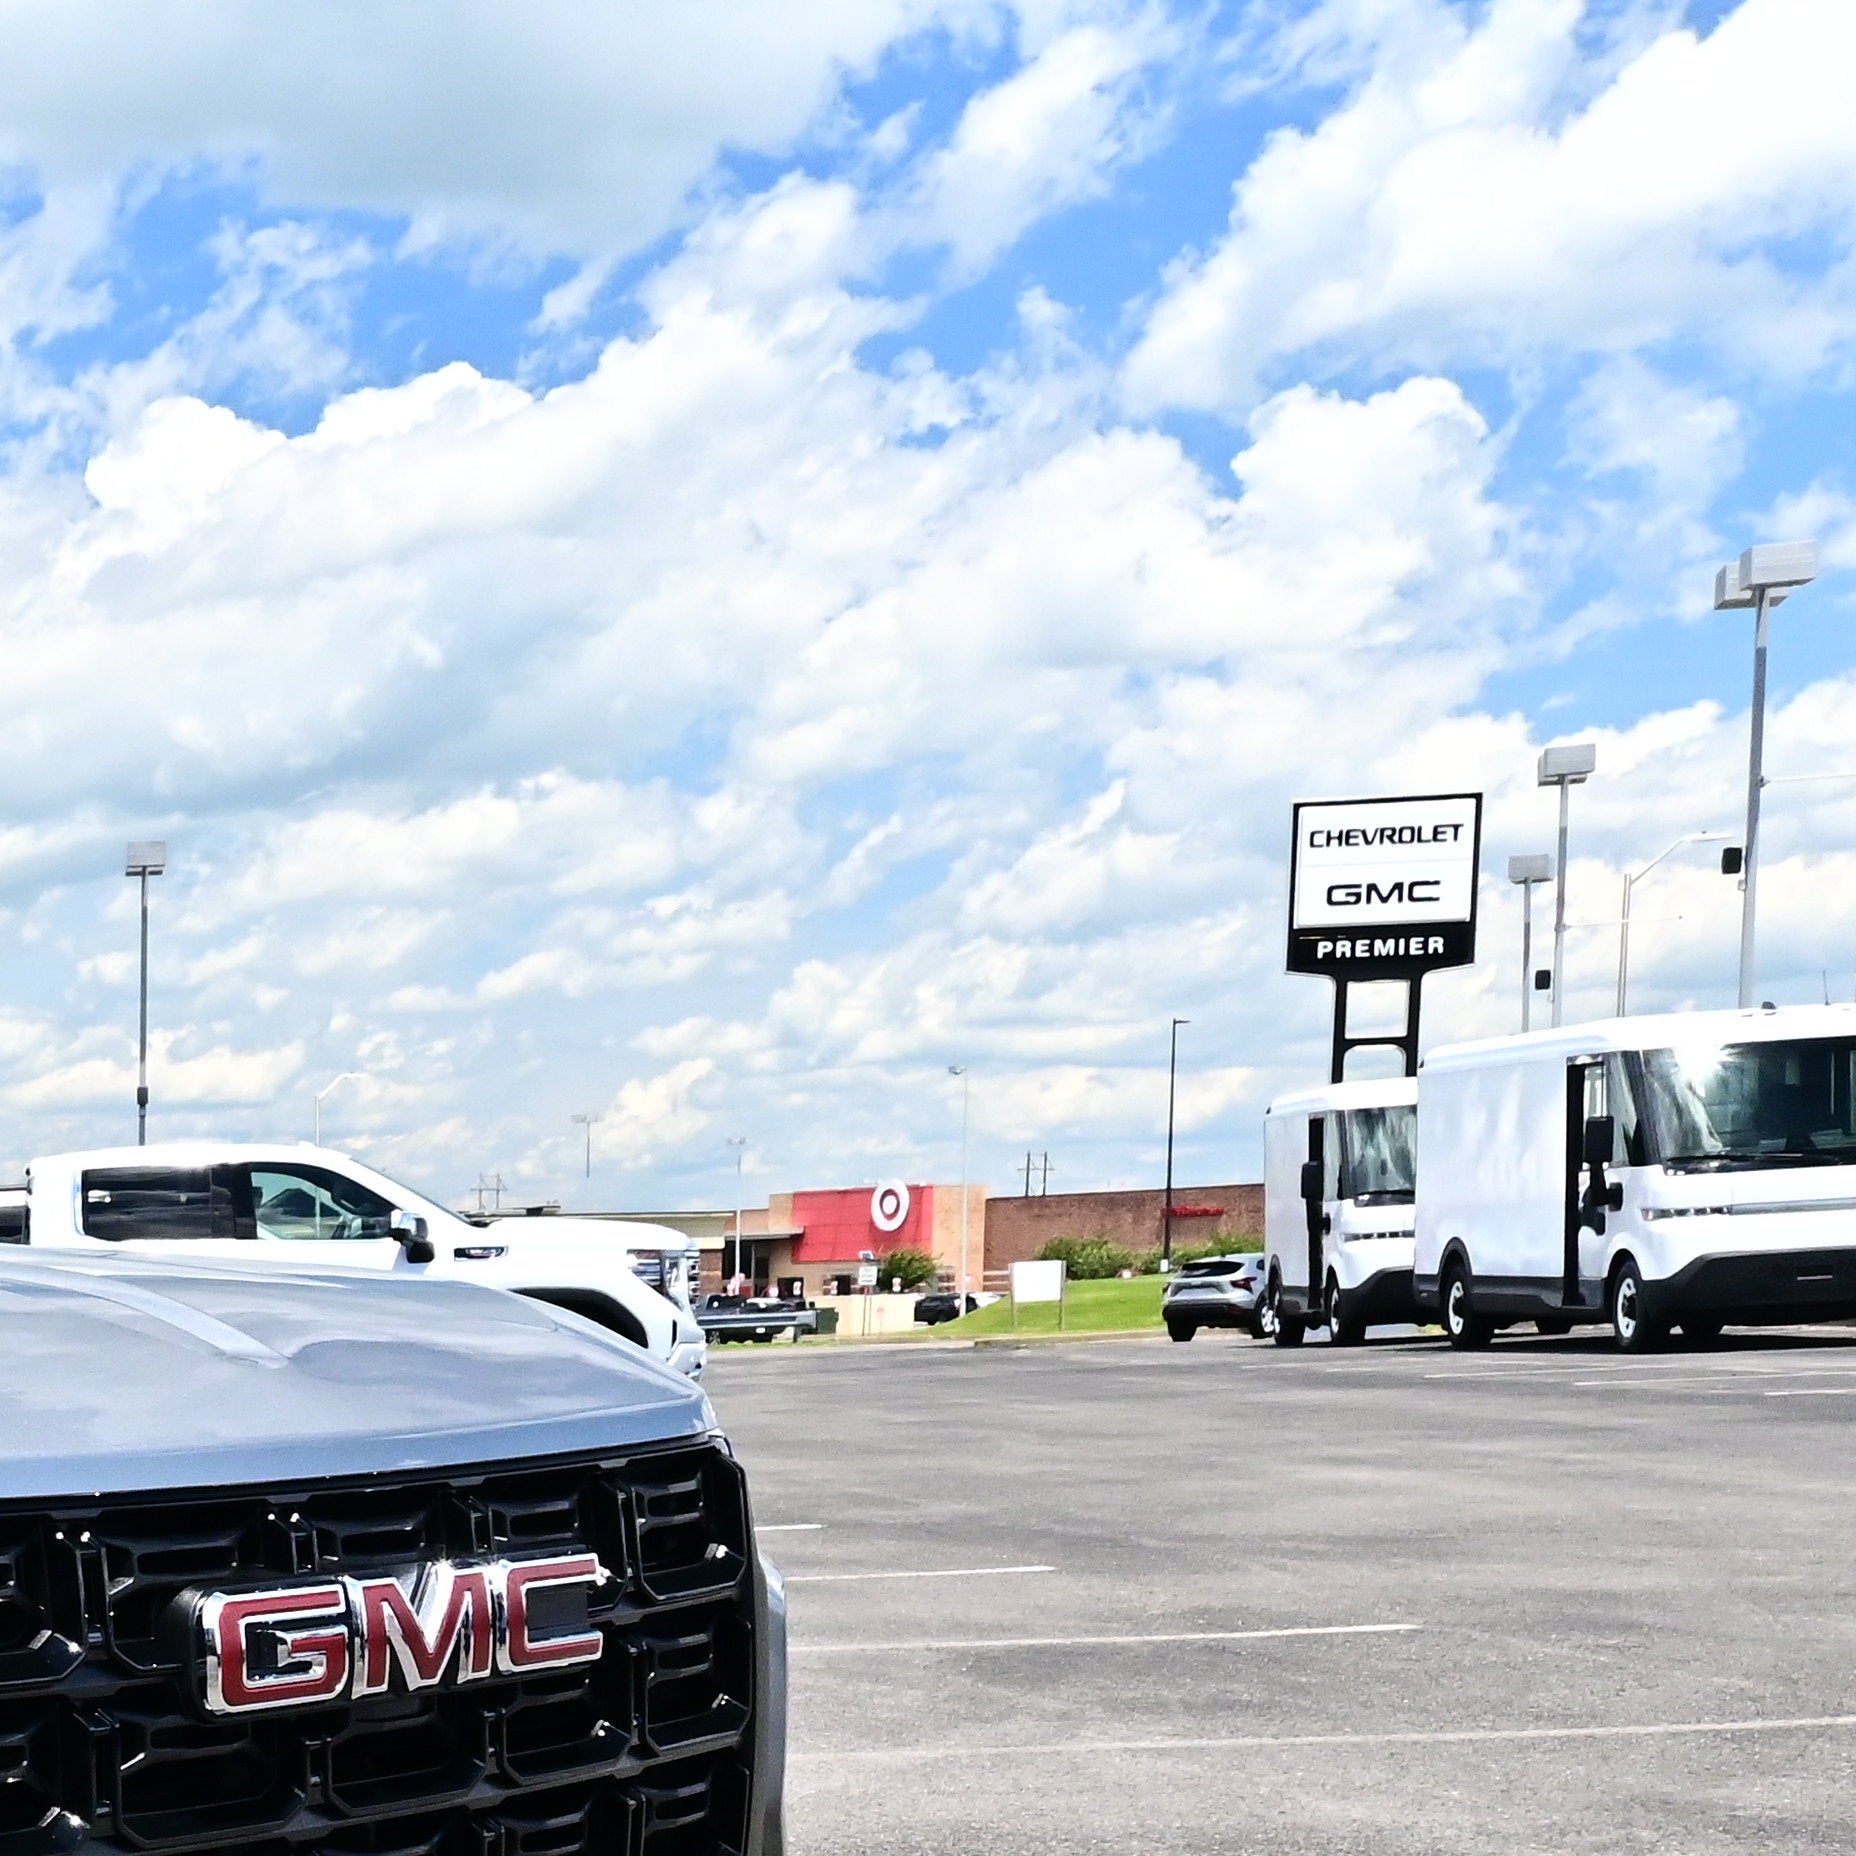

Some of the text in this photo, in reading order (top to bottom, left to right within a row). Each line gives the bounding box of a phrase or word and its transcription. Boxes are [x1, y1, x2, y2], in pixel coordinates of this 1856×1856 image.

[1309, 823, 1465, 848] CHEVROLET
[1326, 880, 1442, 906] GMC
[1316, 936, 1445, 960] PREMIER
[202, 1552, 604, 1715] GMC
